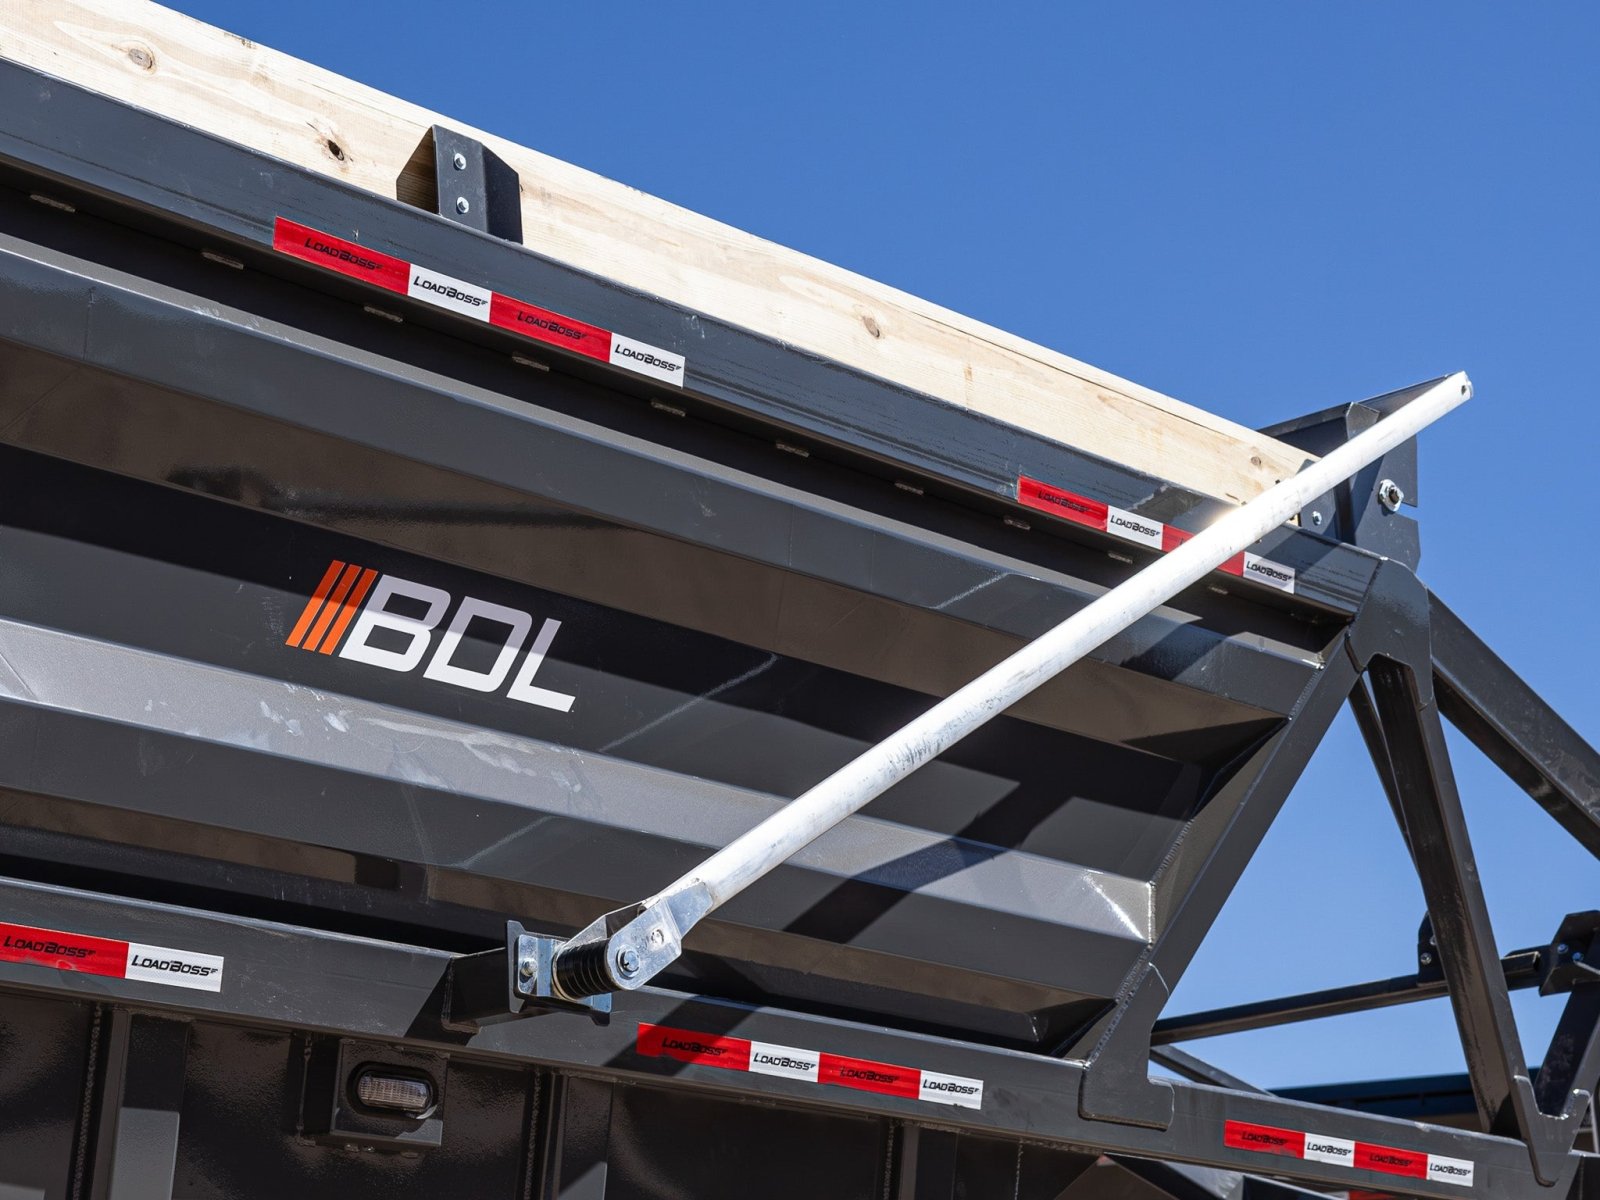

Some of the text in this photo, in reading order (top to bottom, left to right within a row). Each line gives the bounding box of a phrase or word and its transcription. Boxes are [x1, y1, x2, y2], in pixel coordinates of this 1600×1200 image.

[304, 237, 677, 371] LOADBOSS LOADBOSS LOADBOSS LOADBOSS
[1110, 515, 1156, 537] LOADBOSS
[1246, 560, 1289, 581] LOADBOSS
[338, 574, 576, 713] BDL
[3, 935, 211, 977] LOADBOSS LOADBOSS
[661, 1037, 975, 1095] LOADBOSS LOADBOSS LOADBOSS LOADBOSS
[1307, 1142, 1350, 1156] LOADBOSS
[1429, 1163, 1469, 1176] LOADBOSS
